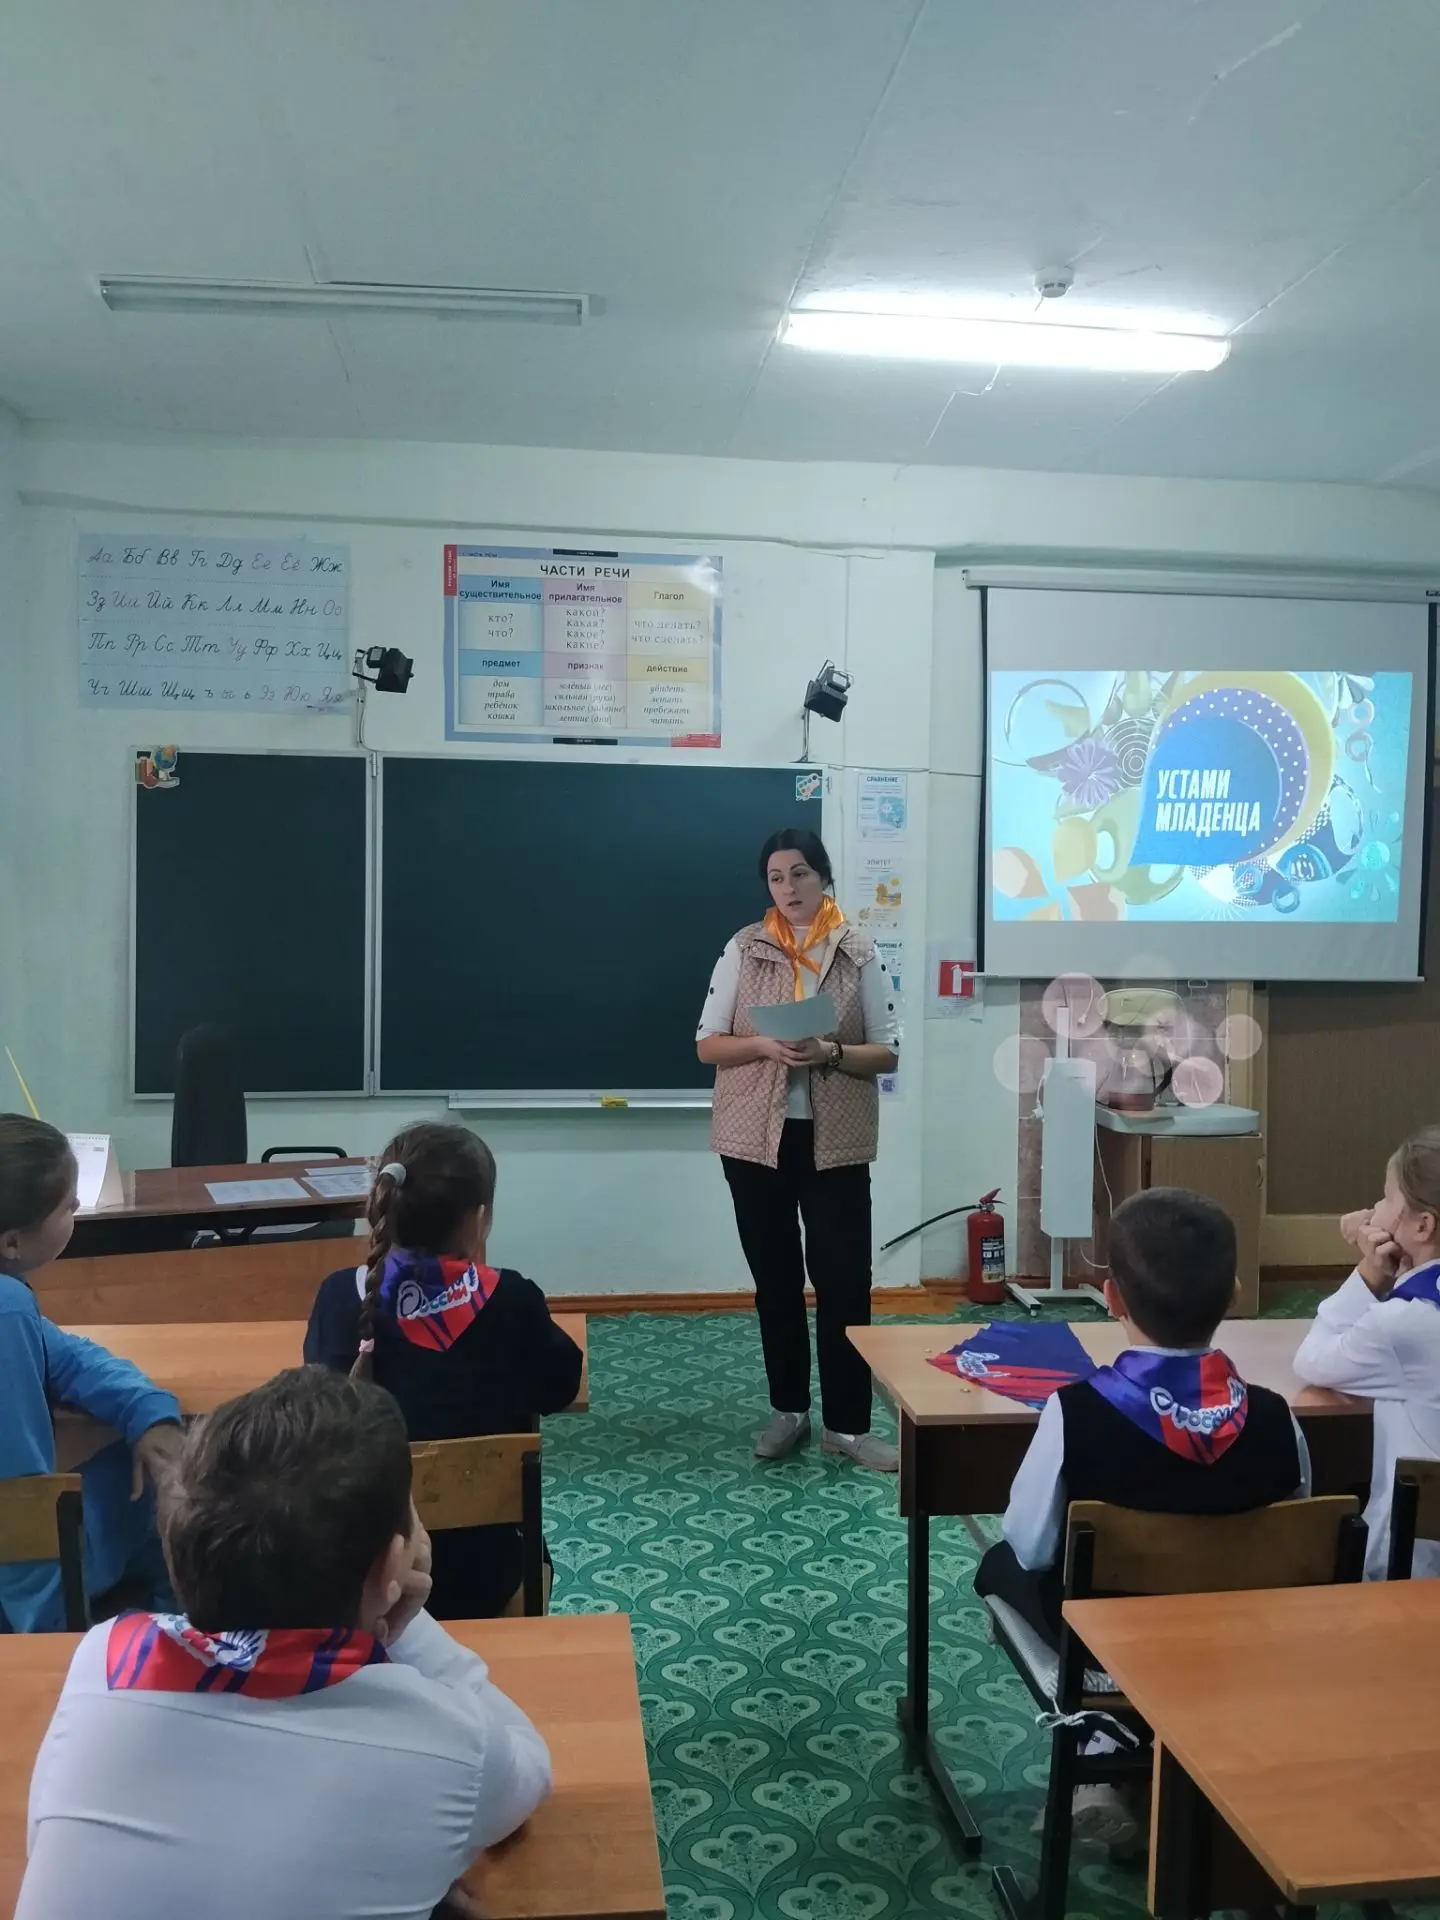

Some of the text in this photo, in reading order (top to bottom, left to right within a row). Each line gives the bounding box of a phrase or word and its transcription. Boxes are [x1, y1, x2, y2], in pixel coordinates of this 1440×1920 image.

[123, 547, 152, 564] Бб
[157, 548, 179, 565] Вв
[189, 550, 208, 567] Гг
[216, 552, 243, 575] Дд
[252, 552, 271, 570] Ее
[310, 556, 343, 572] Жж
[540, 565, 630, 579] ЧАСТИ РЕЧИ
[491, 579, 510, 589] Имя
[576, 583, 595, 592] Имя
[459, 589, 542, 601] существительное
[548, 592, 623, 605] прилагательное
[654, 591, 684, 601] Глагол
[87, 589, 342, 616] Зз Ии Йй Кк Лл Мм Нн Оо
[488, 613, 514, 623] кто?
[488, 627, 514, 638] что?
[88, 632, 342, 662] Пп Рр Сс Тт Уу Фф Хх Цц
[481, 659, 521, 668] предмет
[567, 661, 603, 671] признак
[646, 664, 688, 673] действие
[88, 679, 110, 696] Чч
[119, 680, 152, 697] Шш
[161, 680, 195, 700] Щщ
[1156, 769, 1231, 799] УСТАМИ
[1155, 801, 1261, 838] МЛАДЕНЦА
